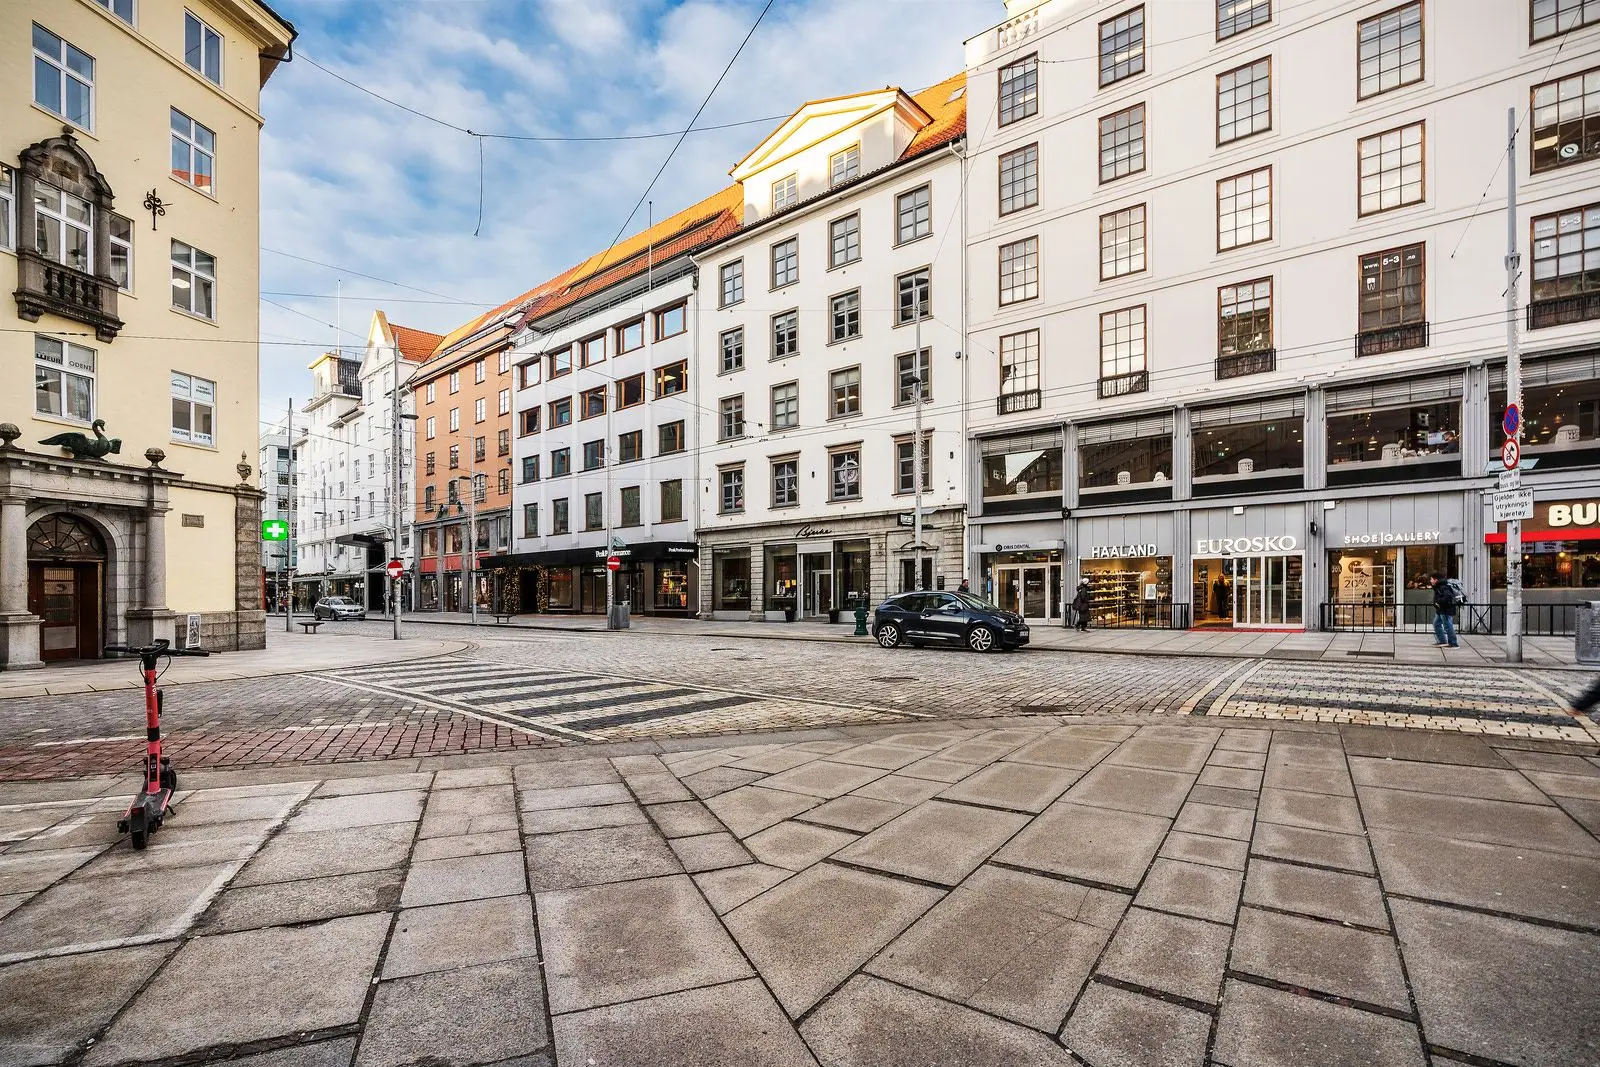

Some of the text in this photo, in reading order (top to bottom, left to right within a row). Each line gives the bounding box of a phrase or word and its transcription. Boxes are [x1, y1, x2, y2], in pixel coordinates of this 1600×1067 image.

[1383, 255, 1399, 265] 5-3
[1494, 494, 1515, 502] Gjelder
[1495, 501, 1530, 510] utryknings-
[1500, 510, 1526, 518] kjøretøy
[1549, 503, 1600, 526] BU
[1196, 535, 1297, 554] EUROSKO
[1092, 544, 1156, 557] HAALAND
